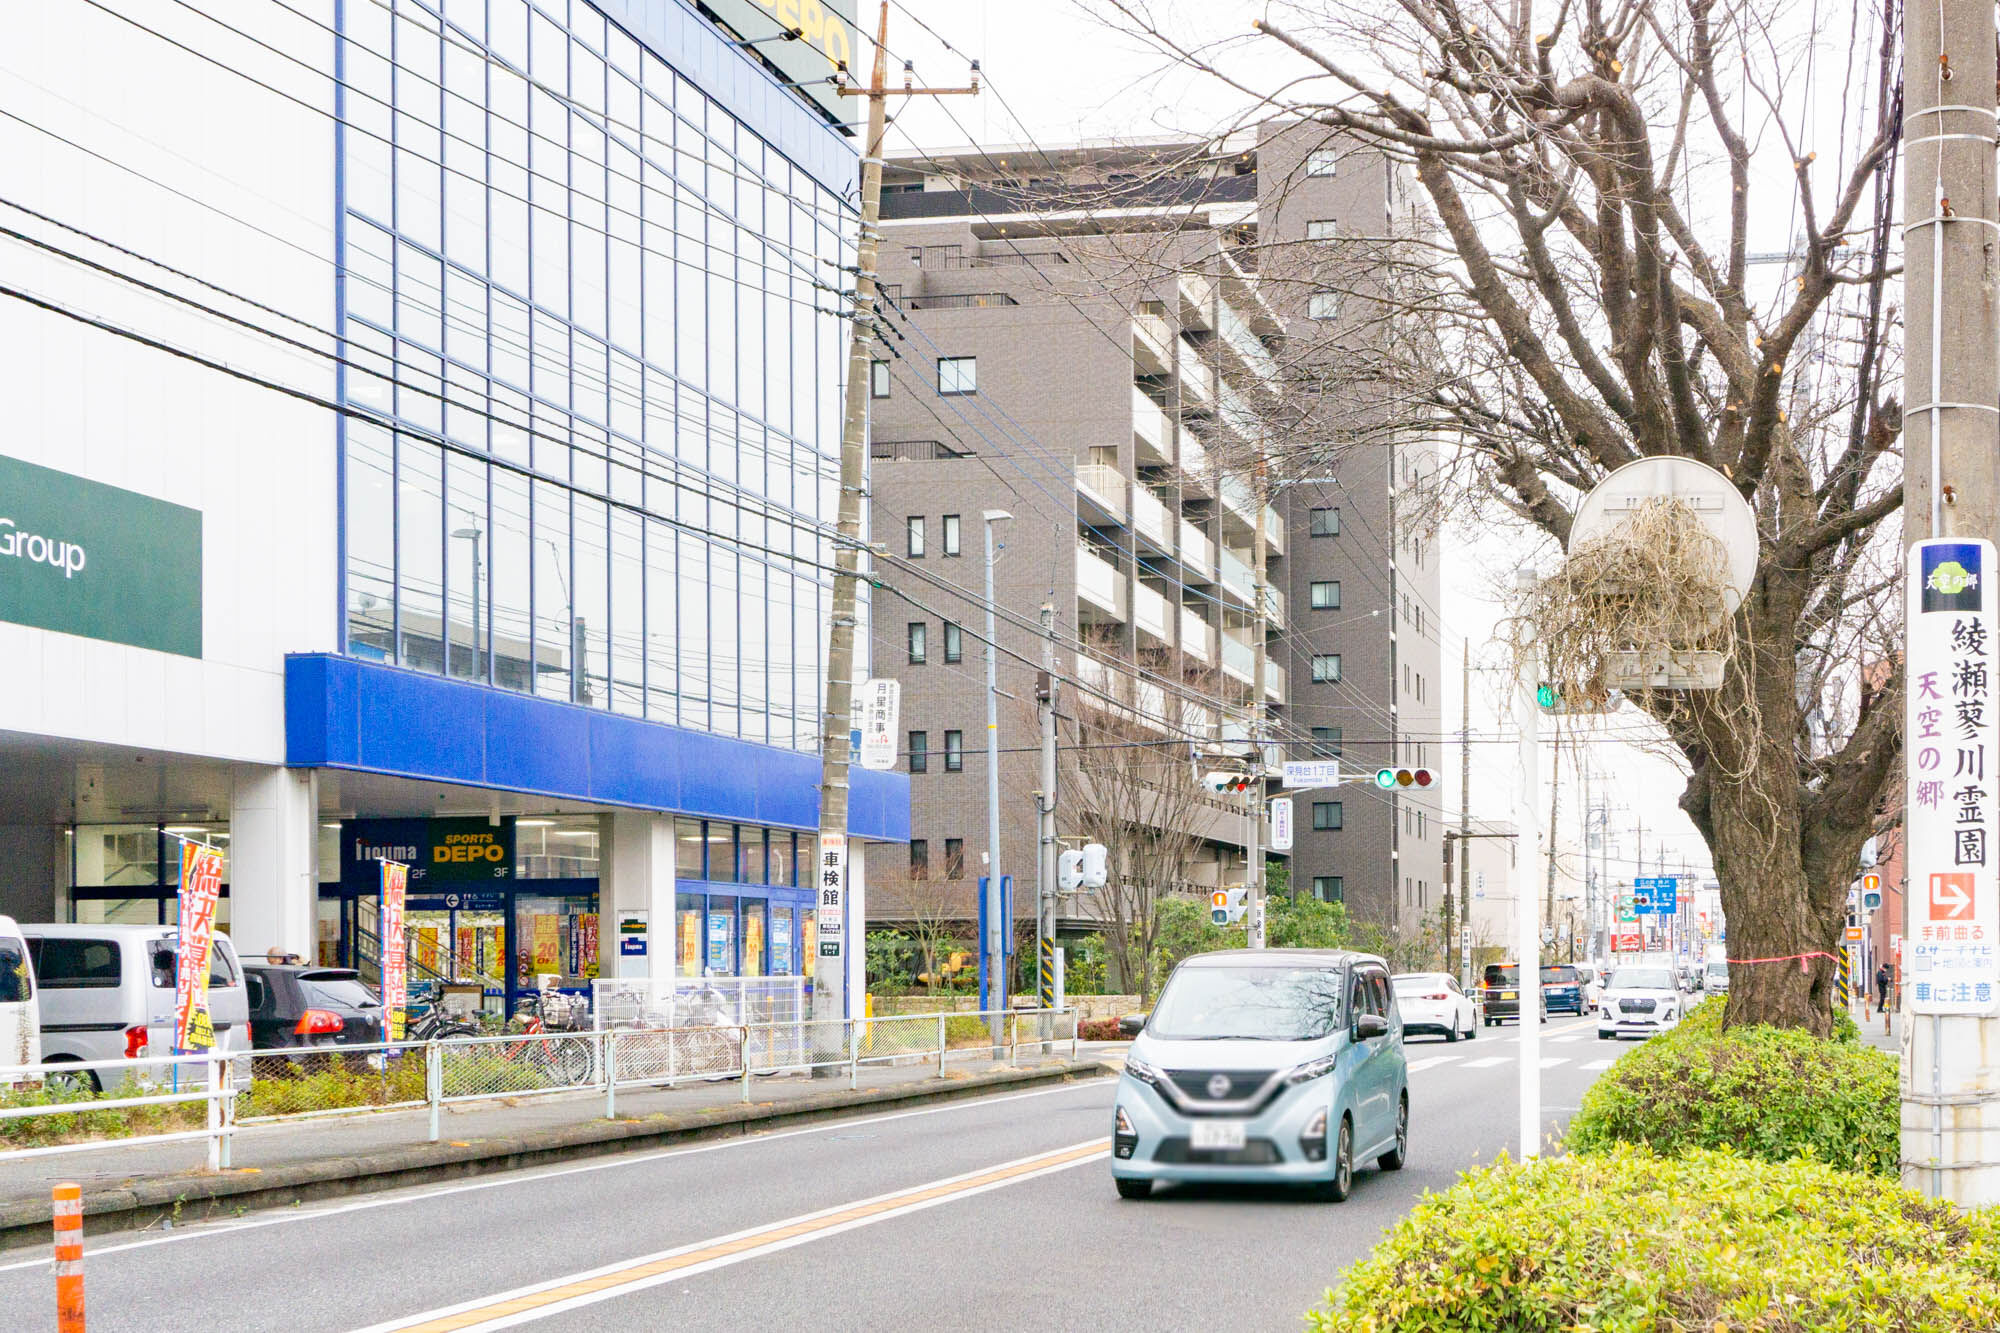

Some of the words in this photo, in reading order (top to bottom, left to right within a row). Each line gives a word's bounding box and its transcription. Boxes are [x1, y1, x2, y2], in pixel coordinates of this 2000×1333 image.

[757, 0, 850, 75] EPO
[0, 518, 86, 579] Group
[1917, 671, 1944, 811] 天空の郷
[1950, 616, 1990, 868] 綾瀬蓼川霊園
[445, 833, 494, 845] SPORTS
[433, 845, 504, 863] DEPO
[412, 868, 427, 879] 2F
[493, 867, 509, 878] 3F
[823, 851, 840, 906] 車検館
[1921, 925, 1984, 941] 手前曲る
[1915, 982, 1992, 1003] 車に注意
